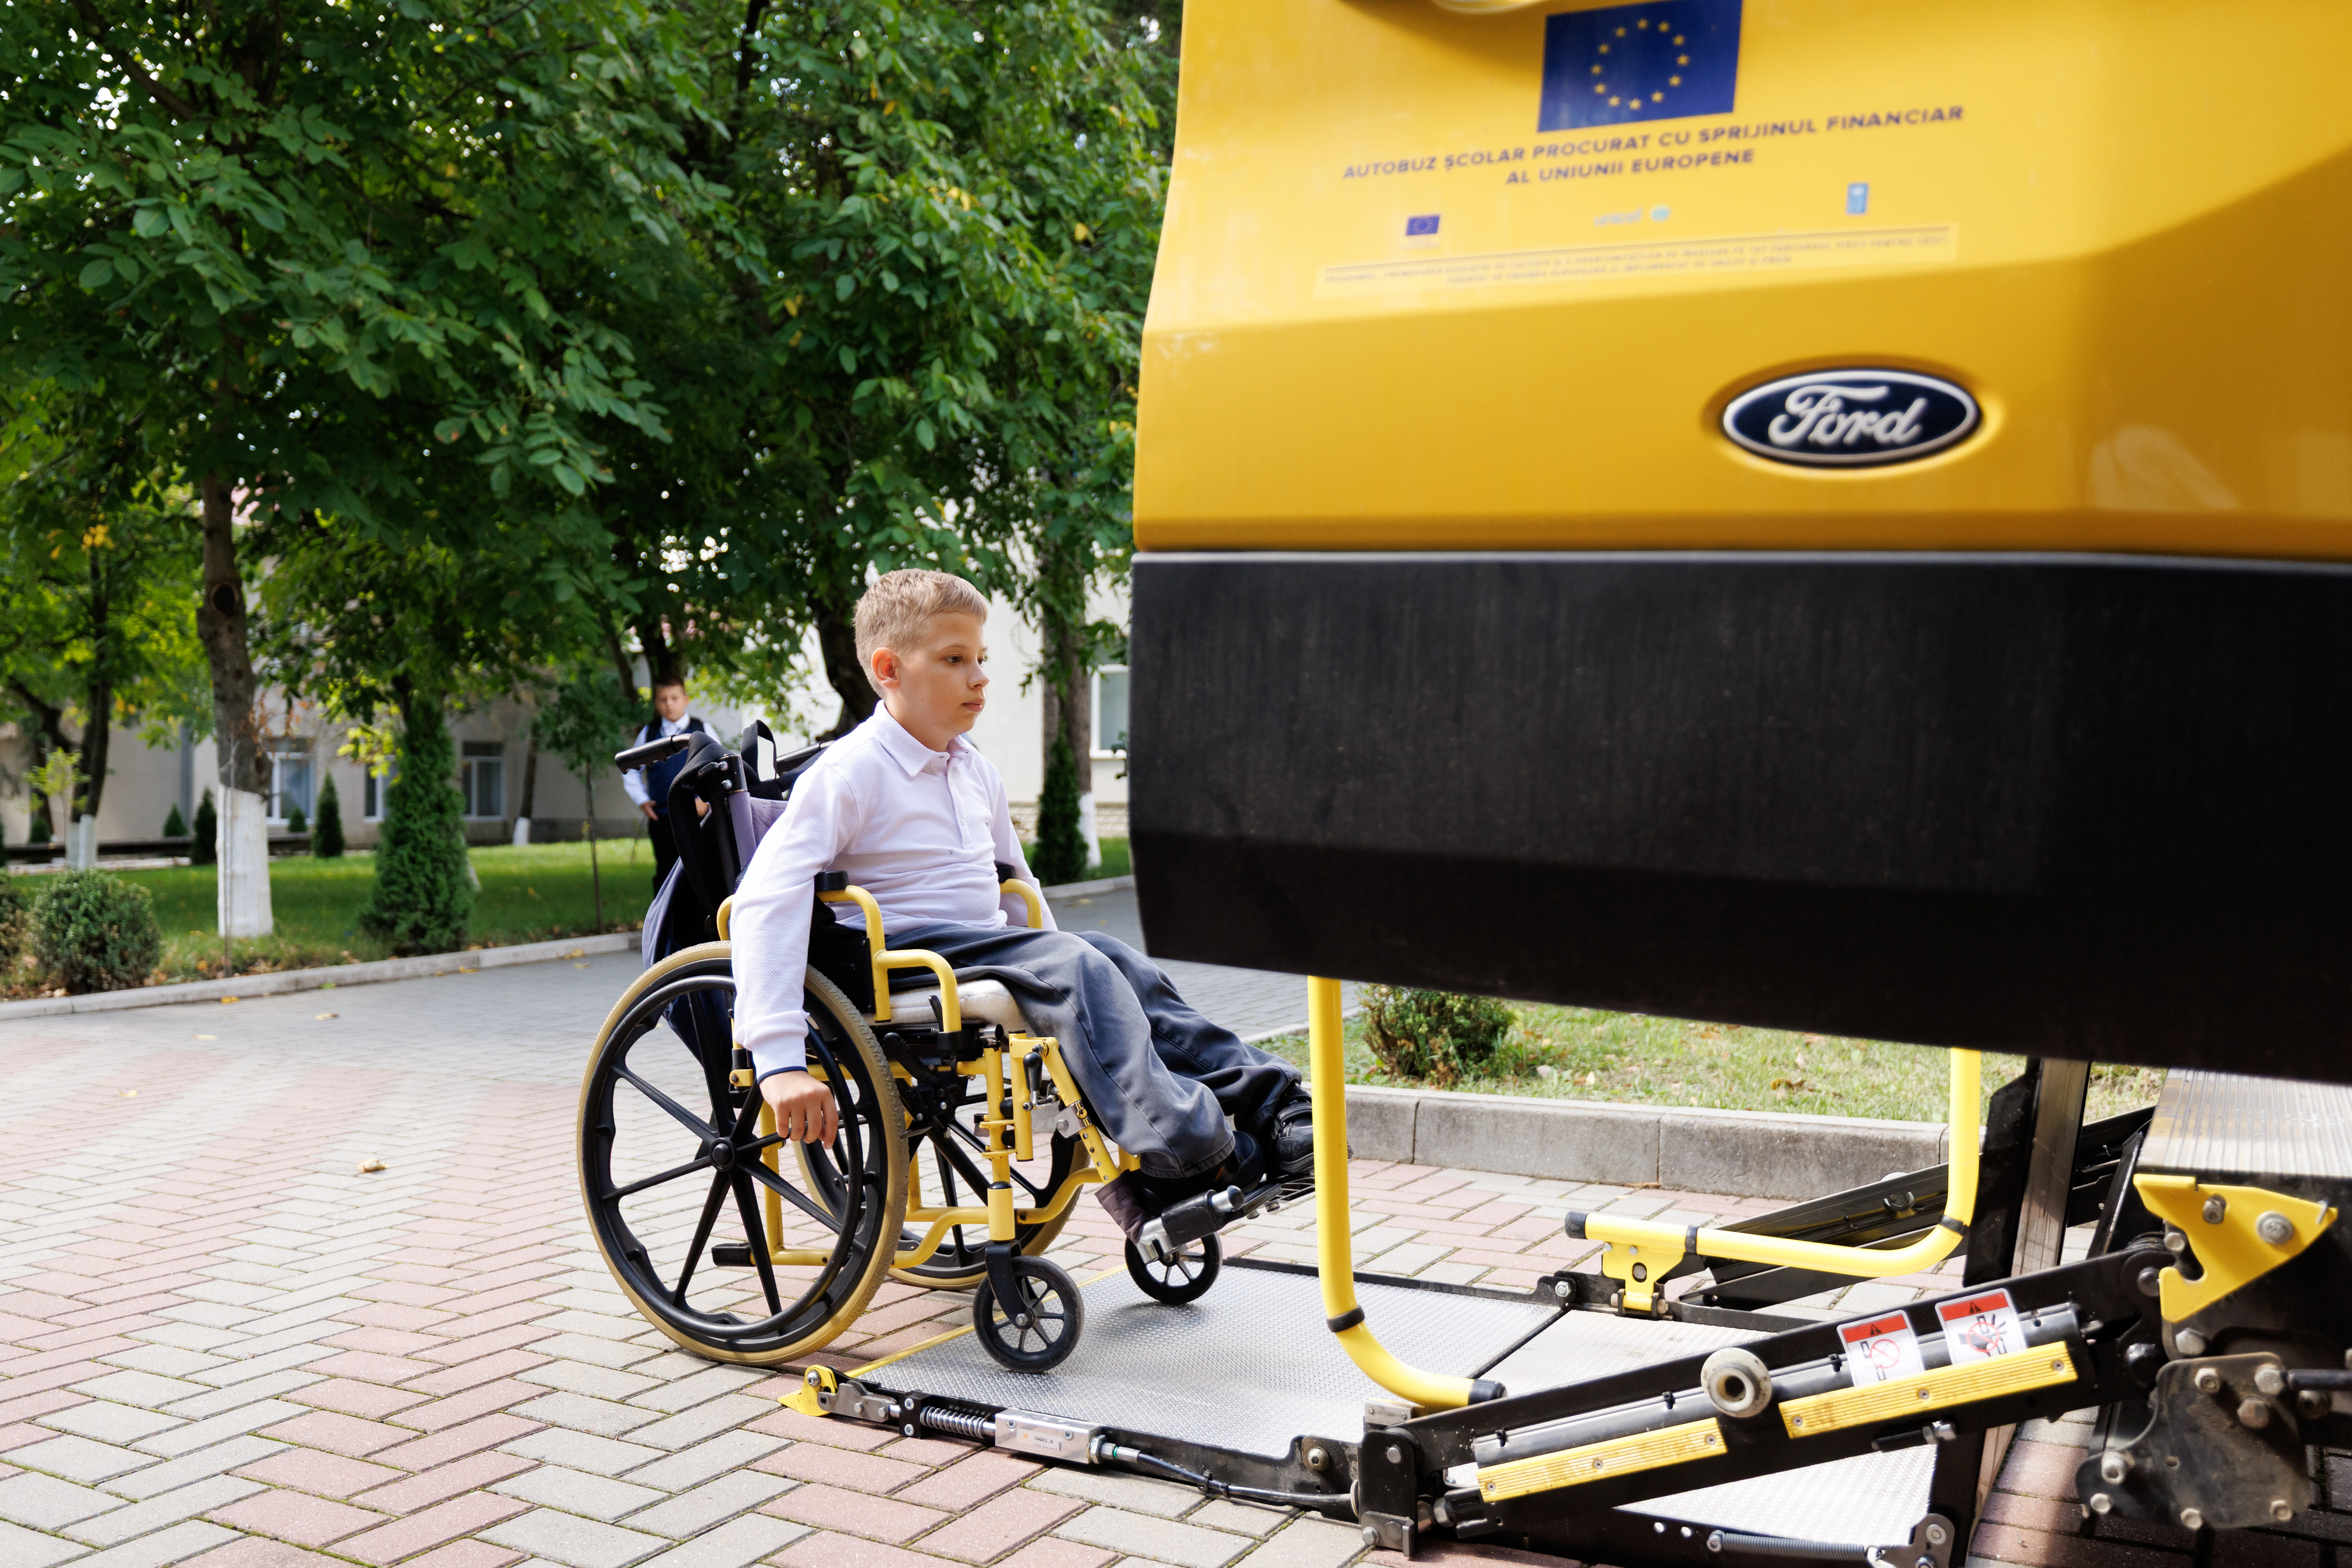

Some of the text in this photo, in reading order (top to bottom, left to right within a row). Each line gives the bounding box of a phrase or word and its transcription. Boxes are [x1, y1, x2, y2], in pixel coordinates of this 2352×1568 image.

[1342, 156, 1438, 179] AUTOBUZ
[1531, 135, 1653, 159] PROCURAT
[1658, 132, 1692, 147] CU
[1698, 120, 1818, 143] SPRIJINUL
[1825, 105, 1965, 131] FINANCIAR
[1505, 148, 1755, 185] AL UNIUNII EUROPENE
[1768, 385, 1927, 446] Ford
